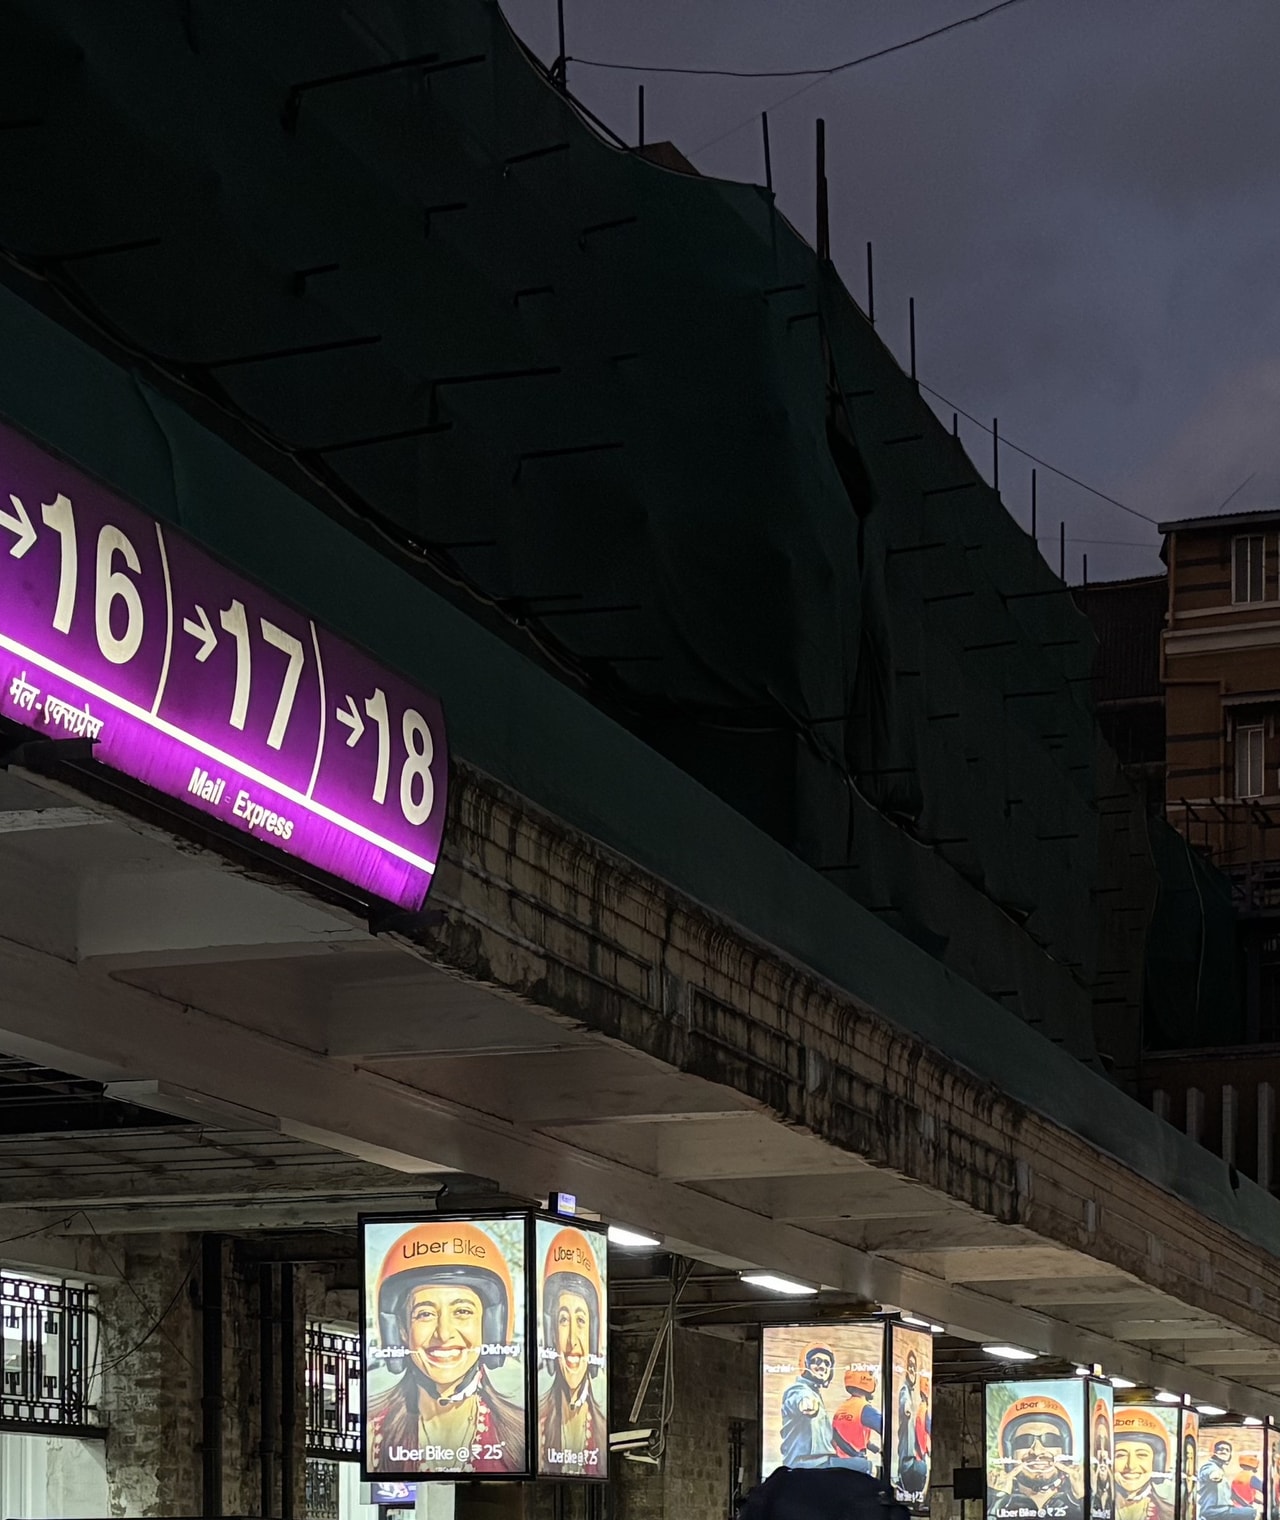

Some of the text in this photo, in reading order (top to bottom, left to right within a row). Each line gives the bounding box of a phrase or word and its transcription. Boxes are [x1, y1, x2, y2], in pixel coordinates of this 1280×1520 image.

[41, 492, 144, 664] 16
[219, 598, 305, 751] 17
[187, 766, 295, 840] Mail Express
[364, 687, 435, 826] 18
[402, 1237, 486, 1259] Uber Bike
[388, 1445, 425, 1461] Uber
[425, 1445, 454, 1461] Bike
[455, 1446, 470, 1462] @
